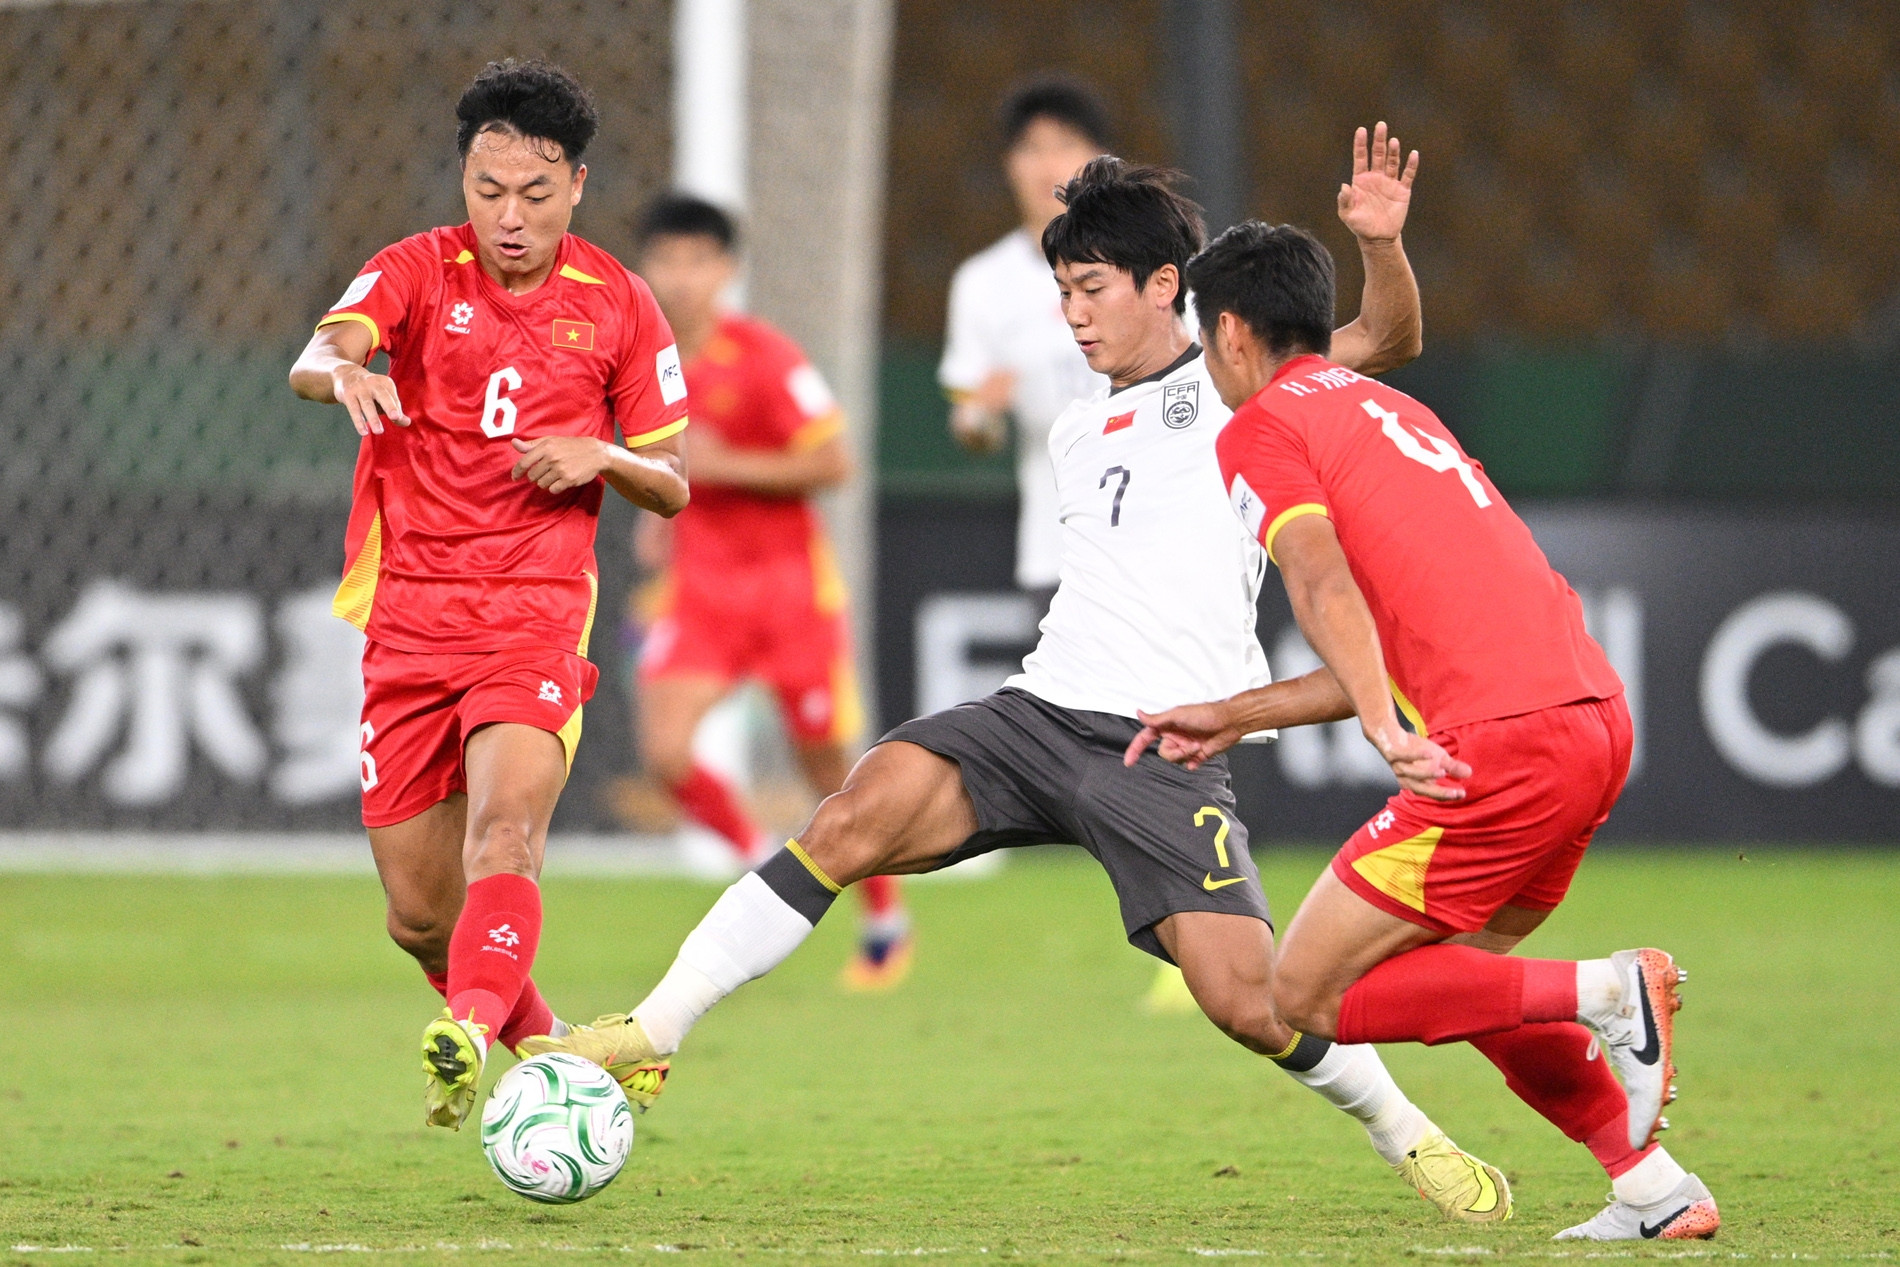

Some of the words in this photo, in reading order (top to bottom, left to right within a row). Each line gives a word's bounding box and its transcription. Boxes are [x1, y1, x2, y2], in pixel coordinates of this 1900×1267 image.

[479, 366, 523, 439] 6
[1167, 384, 1197, 396] CFA
[1359, 398, 1493, 509] 4
[1099, 464, 1131, 527] 7
[360, 720, 379, 794] 6
[1193, 806, 1231, 868] 7
